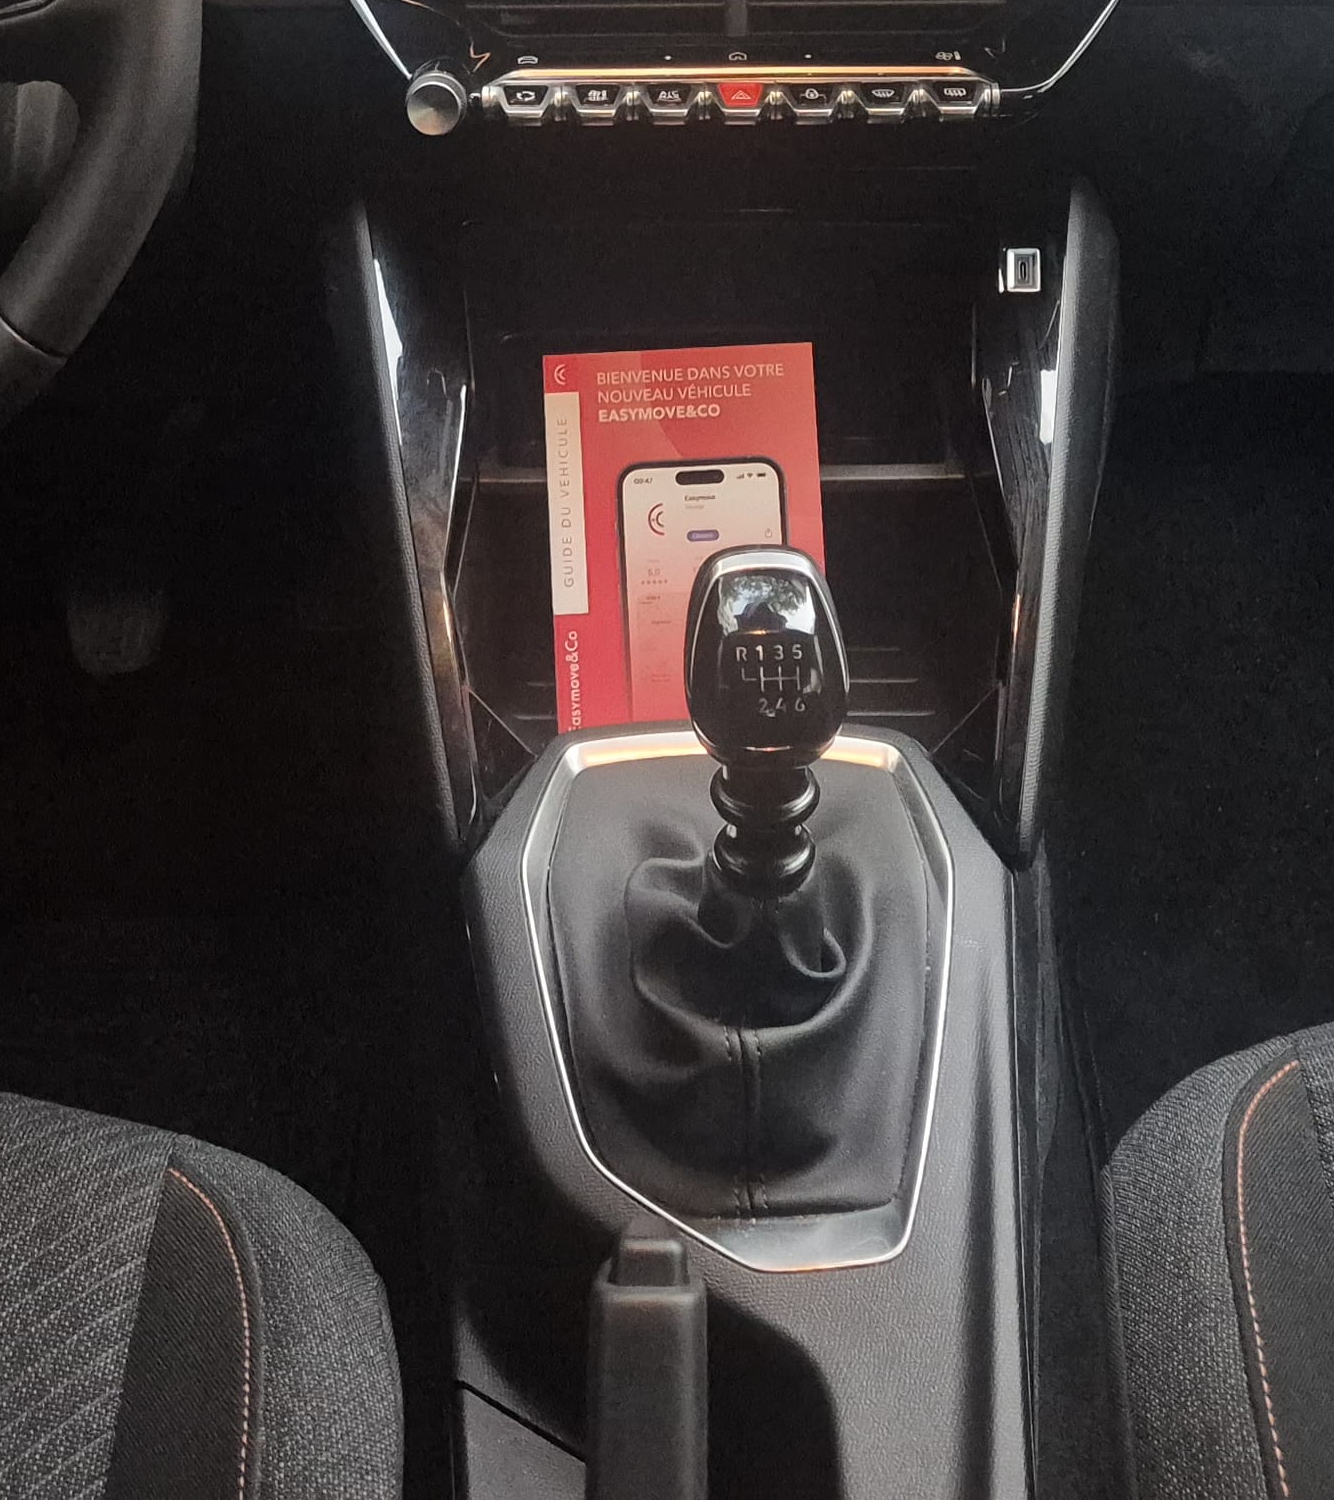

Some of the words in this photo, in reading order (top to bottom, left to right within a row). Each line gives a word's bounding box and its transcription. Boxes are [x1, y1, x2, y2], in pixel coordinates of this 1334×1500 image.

[597, 368, 684, 385] BIENVENUE
[687, 365, 730, 381] DANS
[733, 363, 784, 378] VOTRE
[597, 387, 674, 404] NOUVEAU
[677, 383, 752, 400] VÉHICULE
[598, 404, 721, 423] EASYMOVE&CO
[561, 507, 572, 528] DU
[563, 536, 575, 588] GUIDE
[735, 646, 748, 662] R
[755, 645, 764, 661] 1
[774, 644, 784, 660] 3
[792, 643, 803, 660] 5
[758, 698, 769, 713] 2
[776, 697, 787, 712] 4
[795, 697, 806, 712] 6
